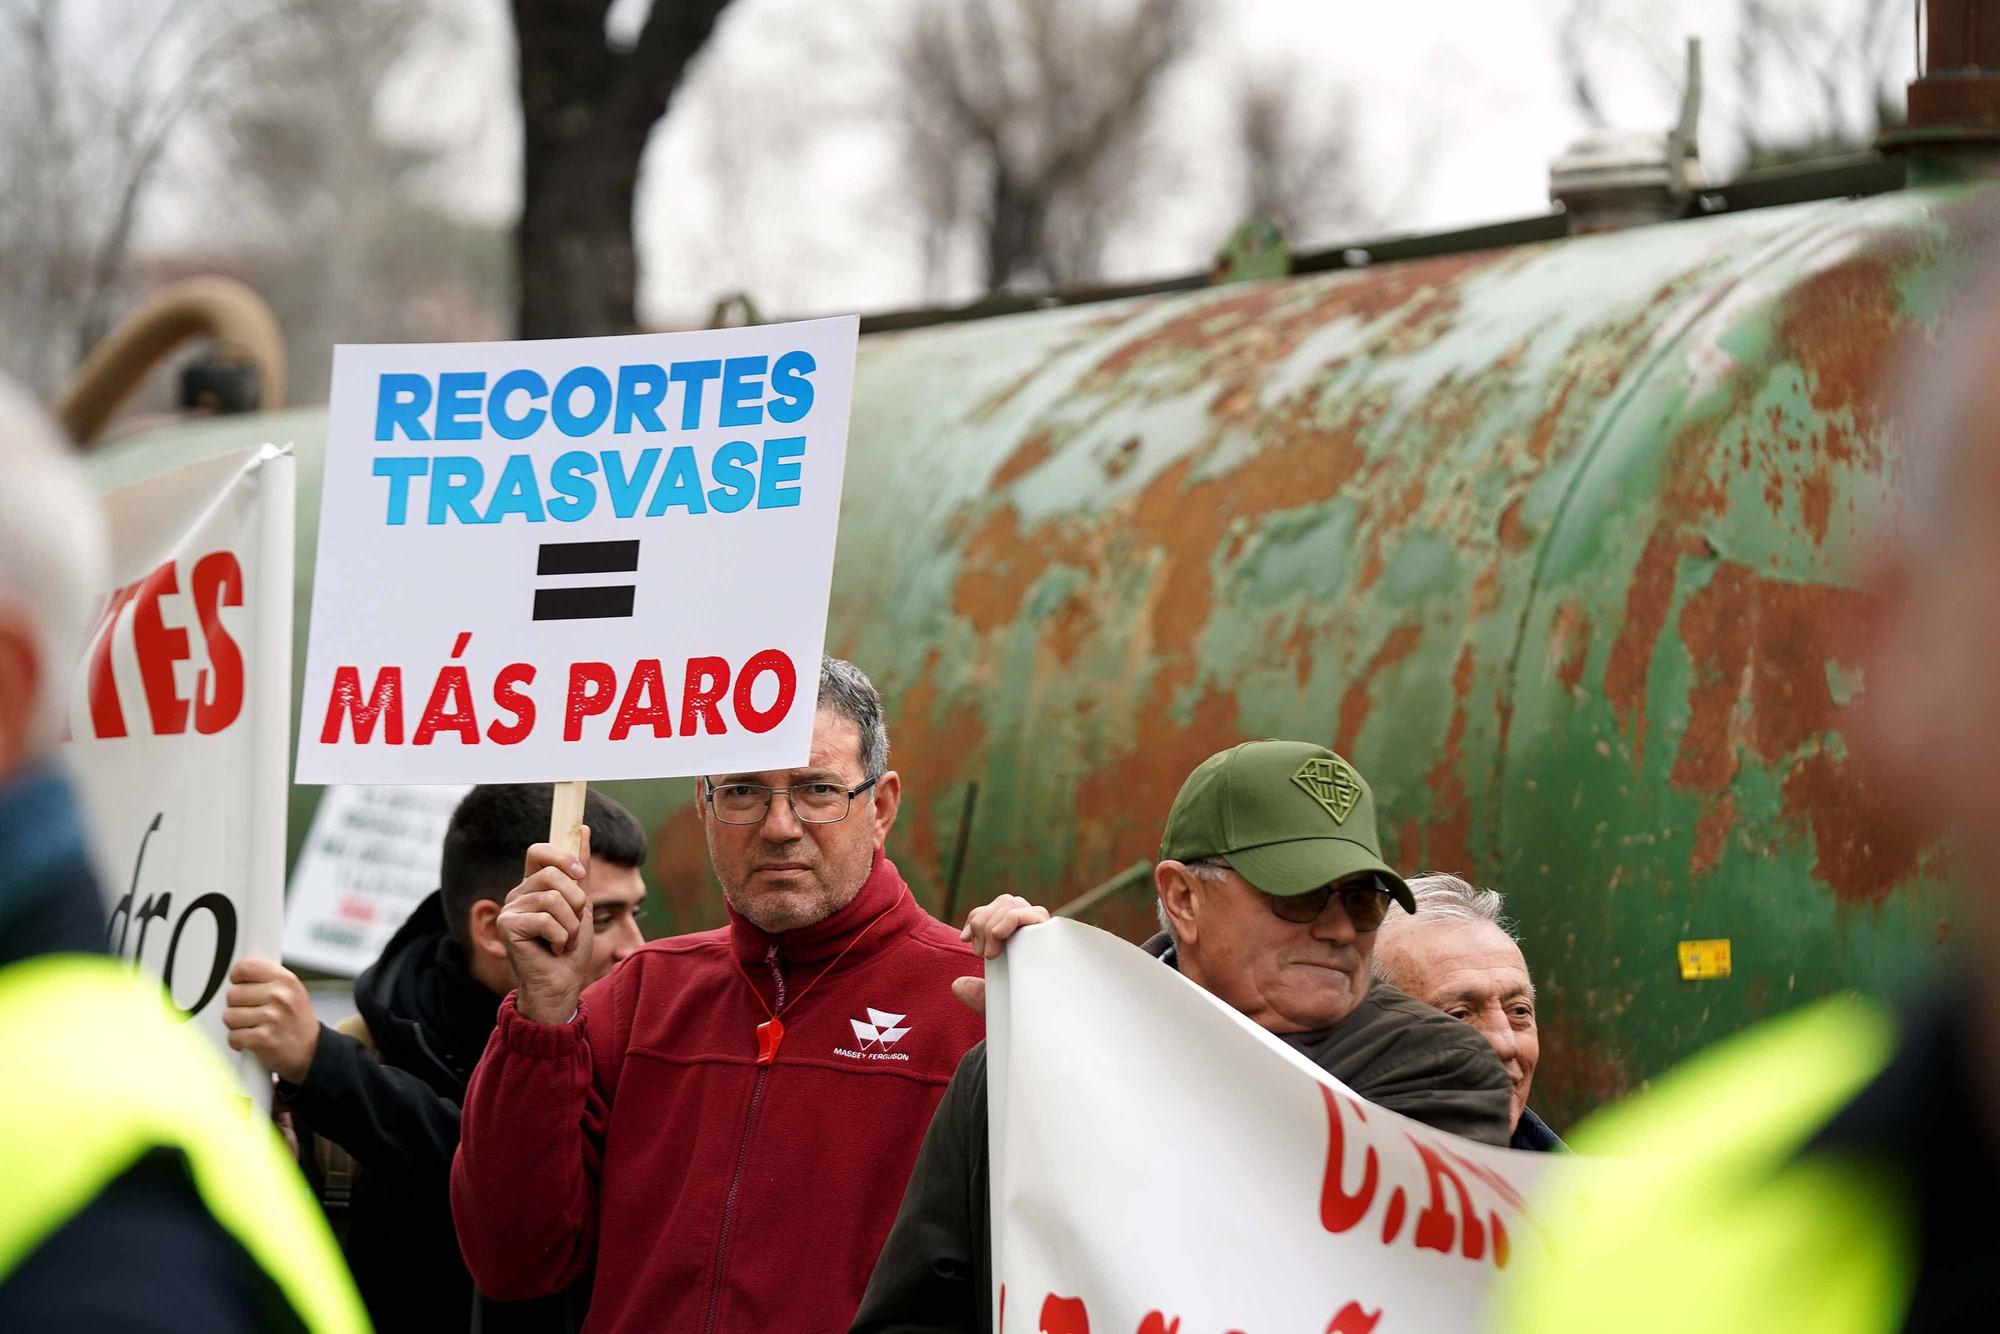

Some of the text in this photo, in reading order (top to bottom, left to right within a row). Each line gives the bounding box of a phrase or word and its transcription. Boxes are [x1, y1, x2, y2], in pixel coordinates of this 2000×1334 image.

[375, 351, 817, 442] RECORTES
[372, 436, 806, 526] TRASVASE
[320, 632, 797, 746] MÁS PARO
[833, 1047, 867, 1059] MASSEY
